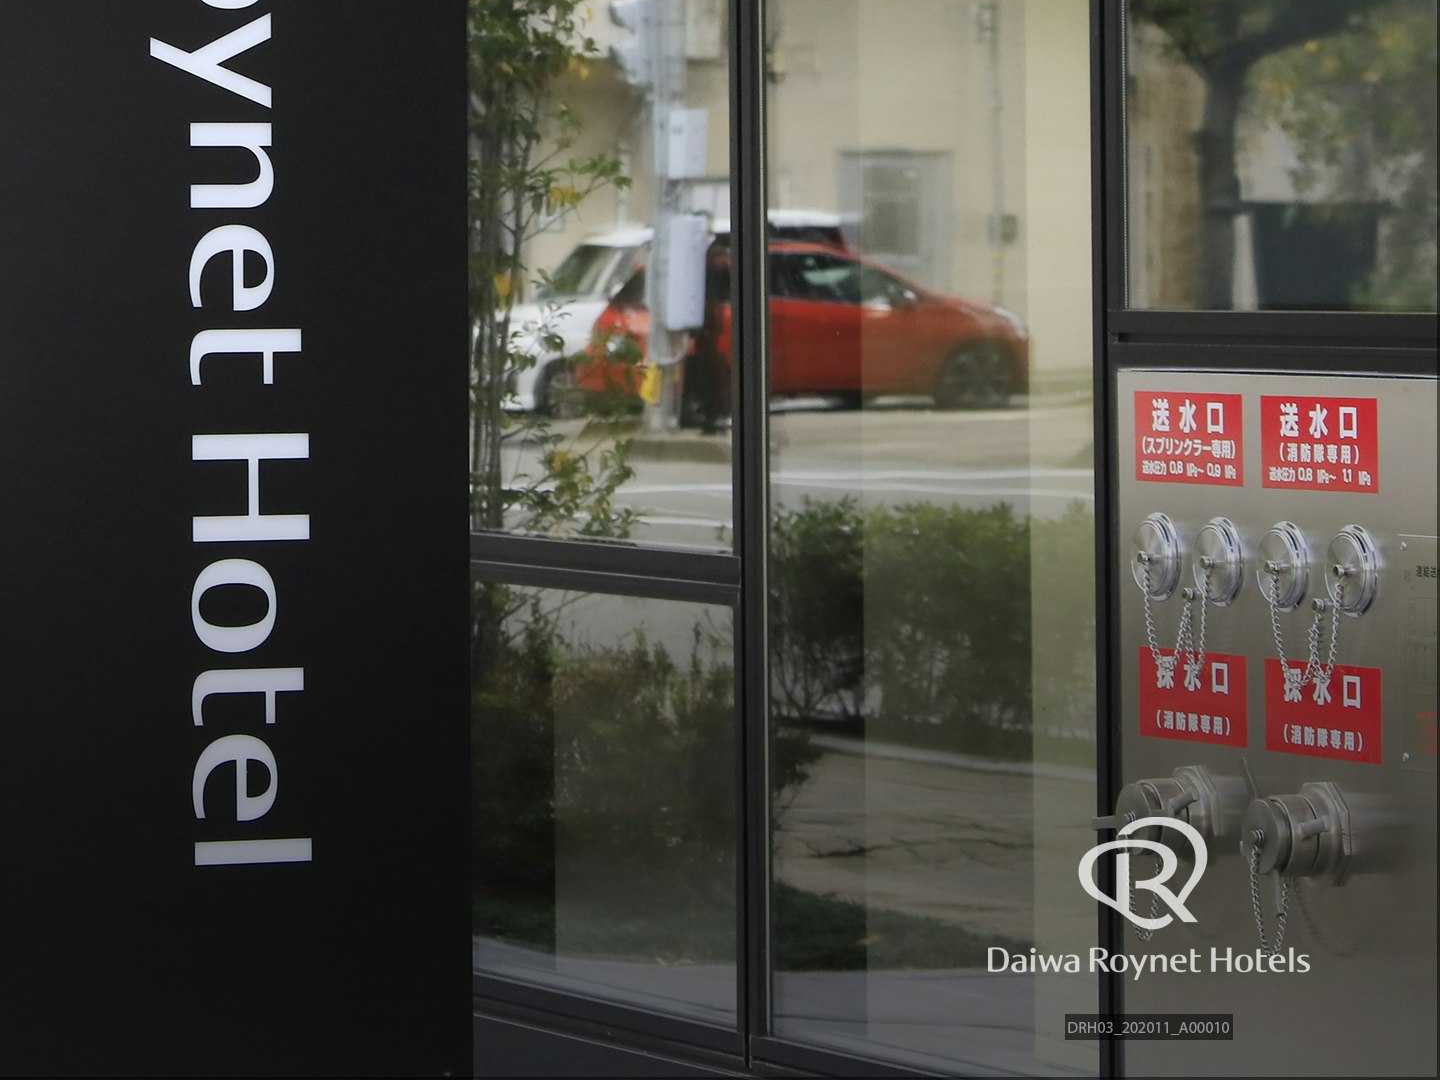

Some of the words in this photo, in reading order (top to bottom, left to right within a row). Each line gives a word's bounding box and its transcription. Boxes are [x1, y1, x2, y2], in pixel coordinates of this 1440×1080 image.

[1152, 399, 1224, 434] 送水口
[1280, 403, 1358, 439] 送水口
[191, 433, 310, 865] Hotel
